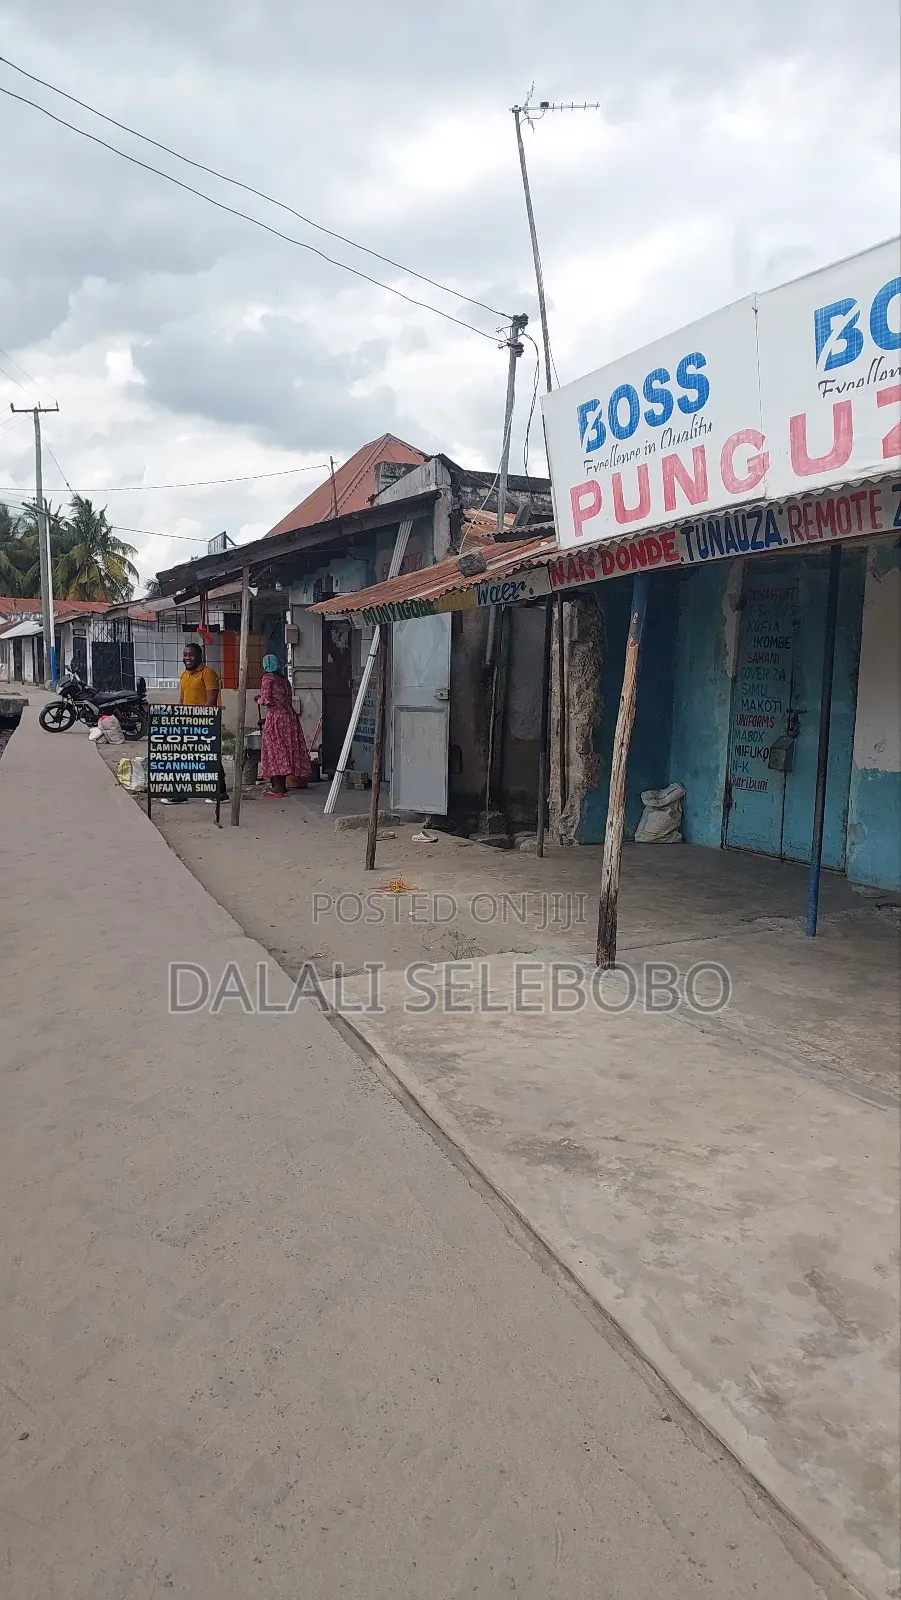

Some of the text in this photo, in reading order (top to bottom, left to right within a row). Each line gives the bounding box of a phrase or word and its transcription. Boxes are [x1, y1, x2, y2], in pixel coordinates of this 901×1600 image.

[577, 351, 711, 454] BOSS
[643, 439, 657, 456] in
[787, 489, 884, 544] REMOTE
[741, 666, 786, 681] COVER ZA
[741, 682, 768, 697] SIMU
[741, 698, 782, 713] MAKOTI
[174, 706, 219, 716] STATIONERY
[161, 716, 214, 726] ELECTRONIC
[736, 713, 776, 729] UNIFORMS
[150, 726, 209, 735] PRINTING
[150, 735, 217, 744] COPY
[150, 743, 211, 752] LAMINATION
[150, 761, 206, 770] SCANNING
[149, 772, 219, 782] VIFAA VYA UMEME
[149, 783, 217, 793] VIFAA VYA SIMU
